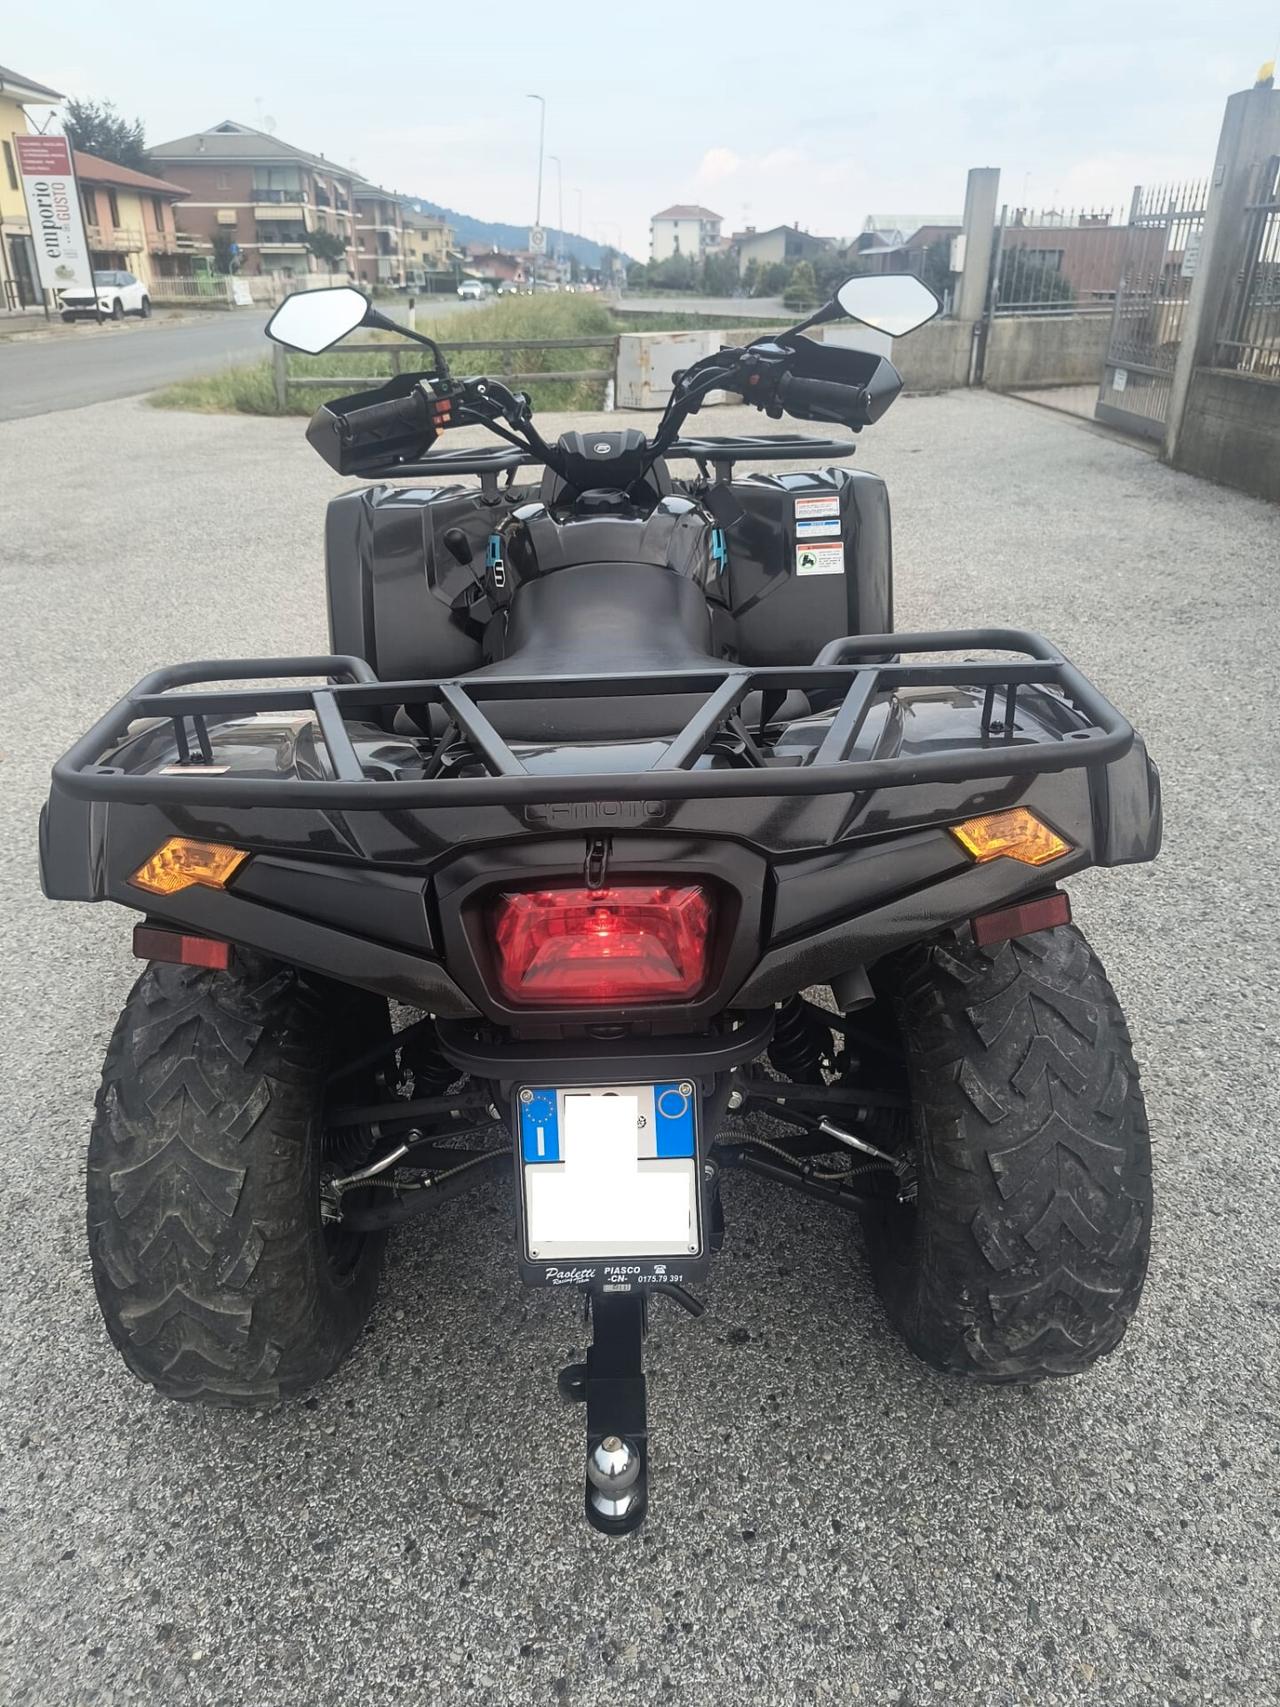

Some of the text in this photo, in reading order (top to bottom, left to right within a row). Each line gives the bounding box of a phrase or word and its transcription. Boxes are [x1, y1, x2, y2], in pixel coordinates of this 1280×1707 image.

[51, 182, 71, 221] GUSTO
[32, 182, 62, 258] emporio
[536, 1126, 545, 1156] I
[545, 1267, 596, 1280] Paoletti
[604, 1266, 641, 1275] PIASCO
[669, 1274, 683, 1282] 391
